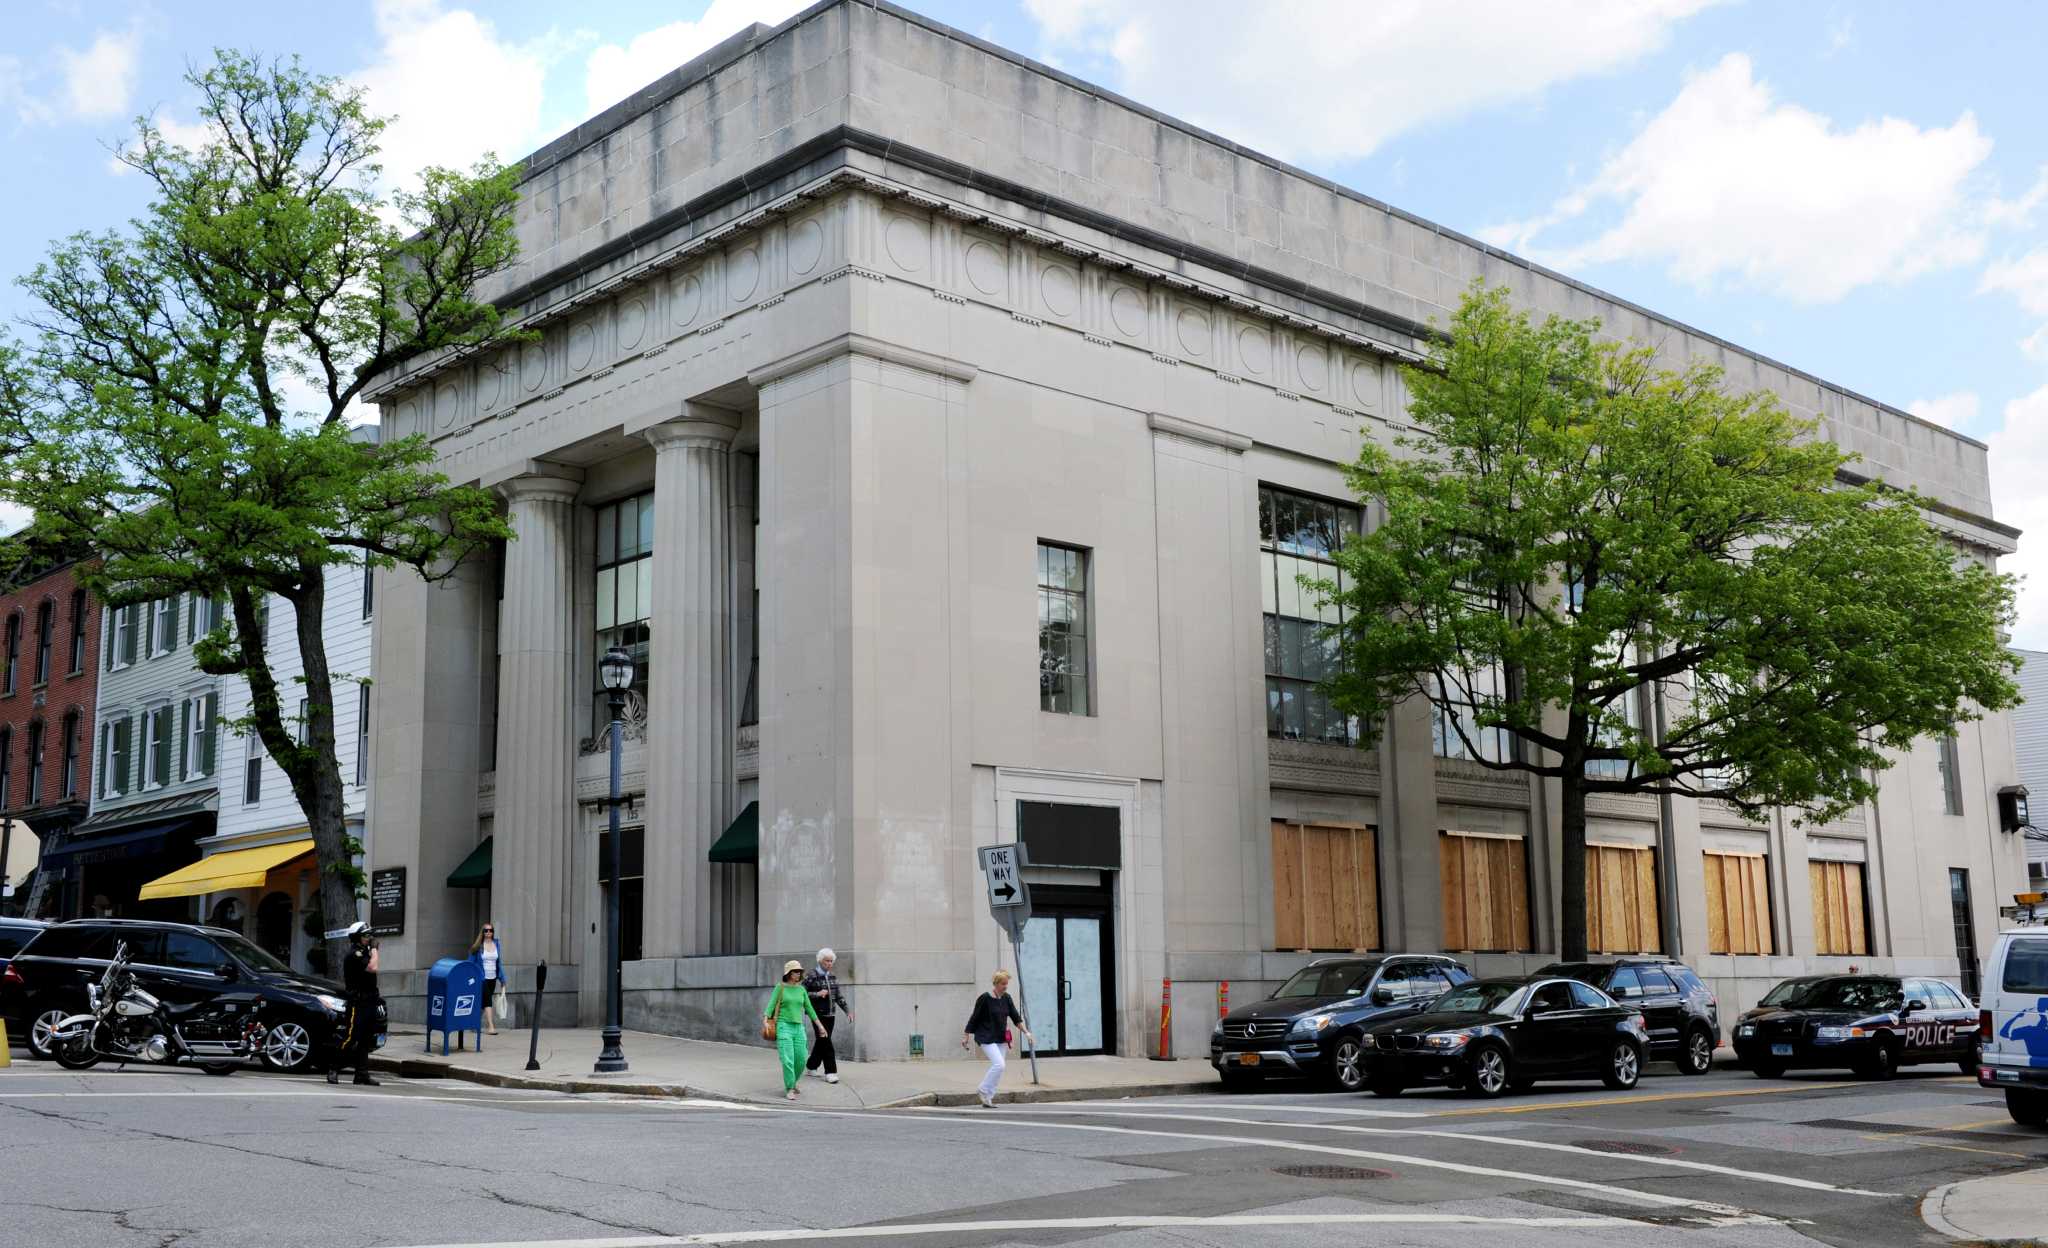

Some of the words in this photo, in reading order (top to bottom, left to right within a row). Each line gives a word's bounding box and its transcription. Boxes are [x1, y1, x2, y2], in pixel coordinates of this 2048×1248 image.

[991, 850, 1009, 865] ONE
[992, 866, 1011, 881] WAY
[1904, 1025, 1954, 1048] POLICE
